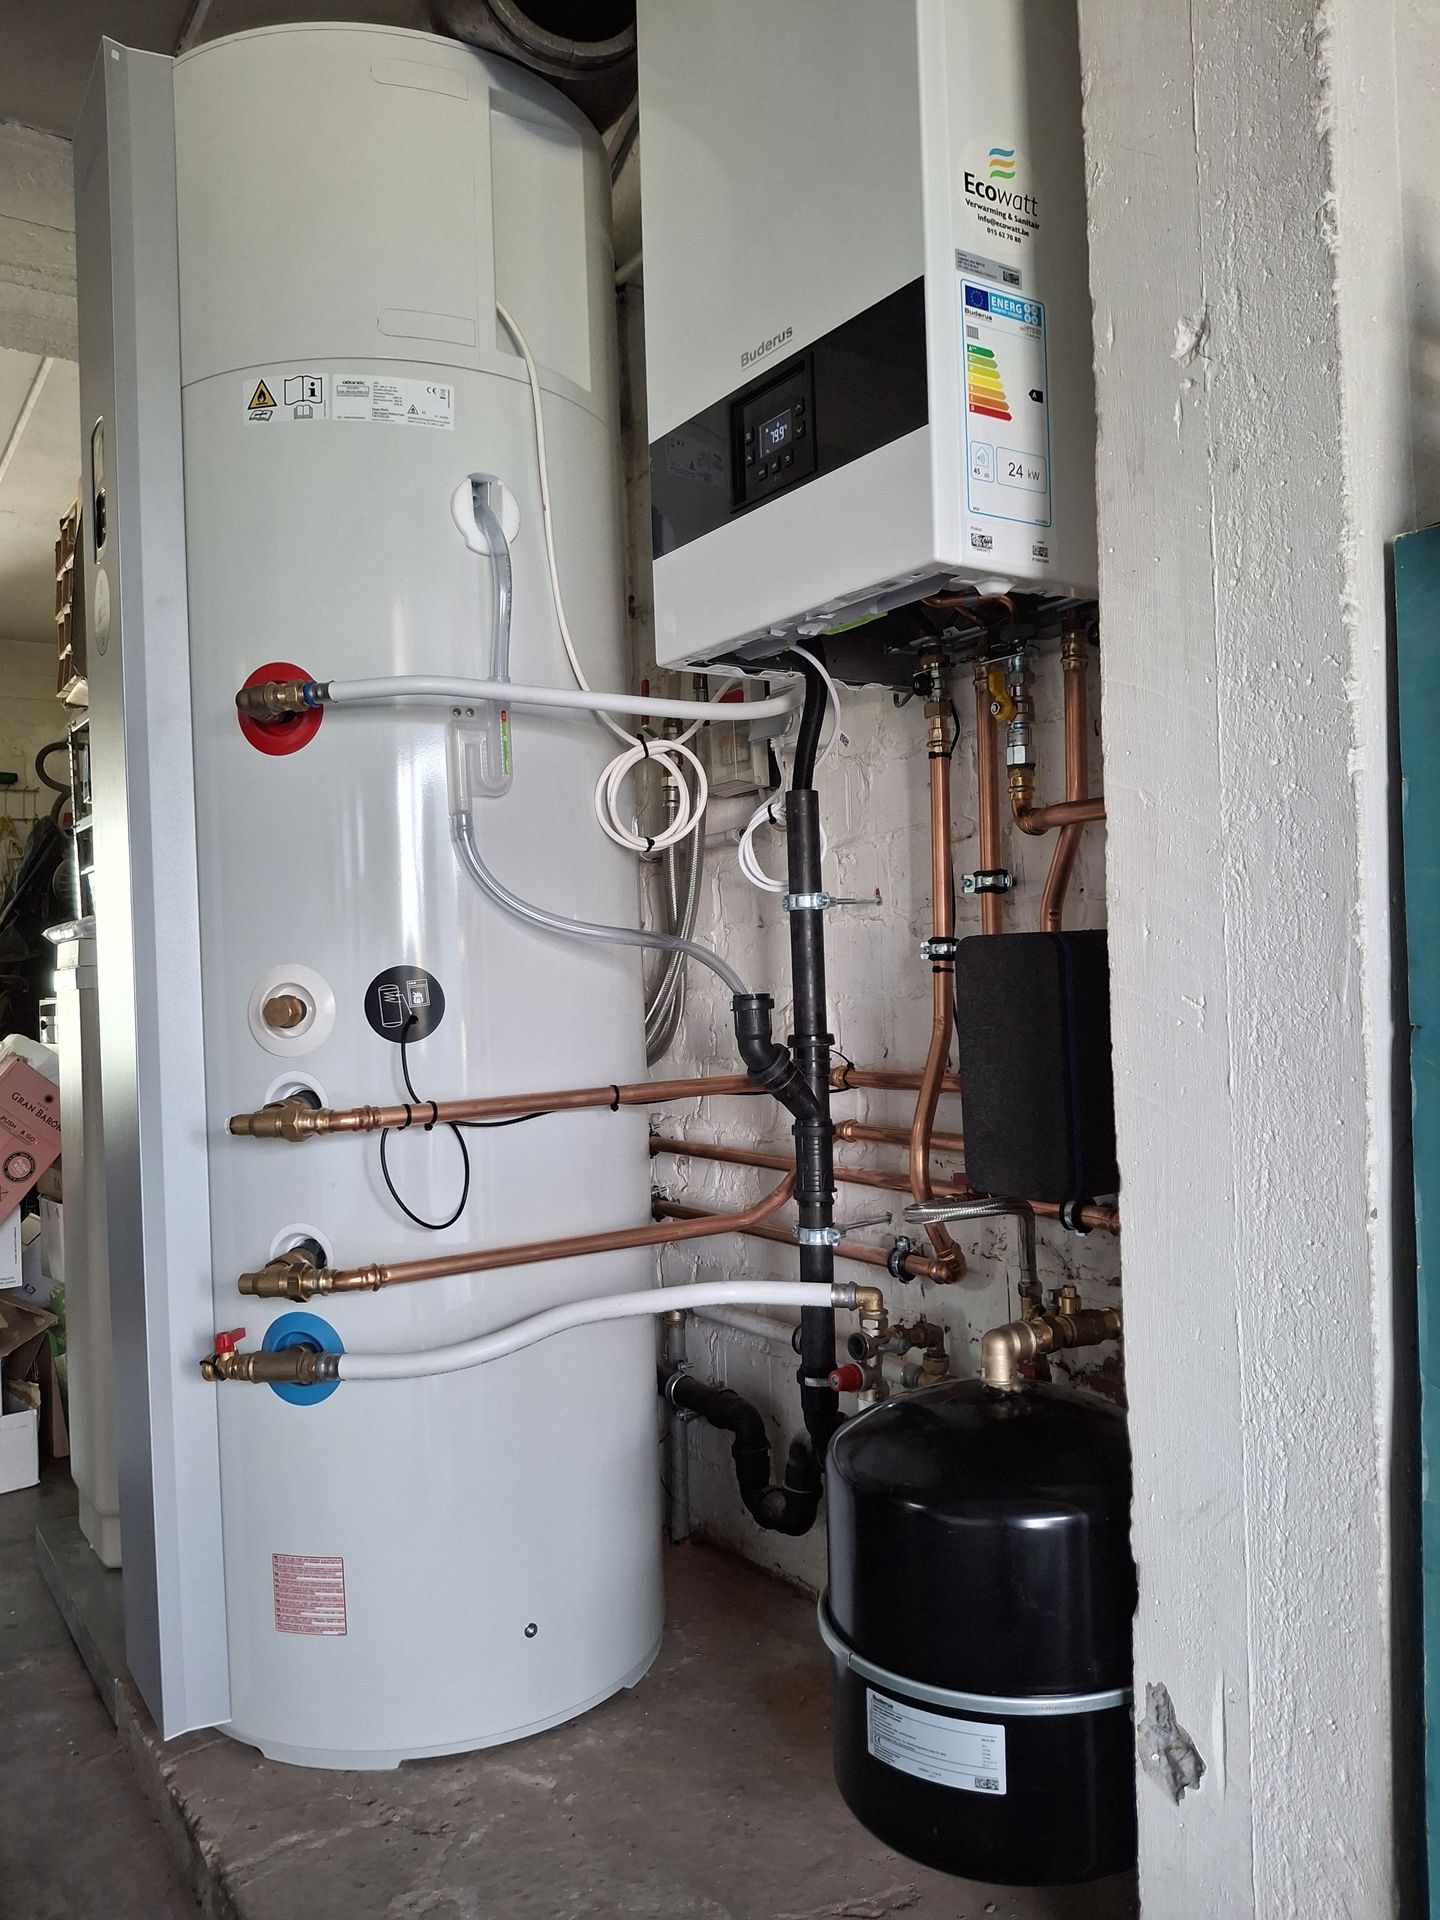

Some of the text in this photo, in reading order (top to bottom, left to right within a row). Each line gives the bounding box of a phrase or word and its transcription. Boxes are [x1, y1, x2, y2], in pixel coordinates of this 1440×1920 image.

[964, 171, 1038, 217] Ecowatt
[965, 198, 1040, 229] Verwarming & Sanitair
[977, 213, 1029, 236] info@ecowatt.be
[987, 227, 997, 236] 015
[965, 307, 992, 321] Buderus
[991, 296, 1022, 314] ENERG
[741, 325, 793, 368] Buderus
[974, 467, 980, 475] 45
[1008, 462, 1040, 481] 24 kW
[12, 1092, 36, 1112] GRAN
[0, 1115, 17, 1129] PUSH
[26, 1133, 35, 1142] GO
